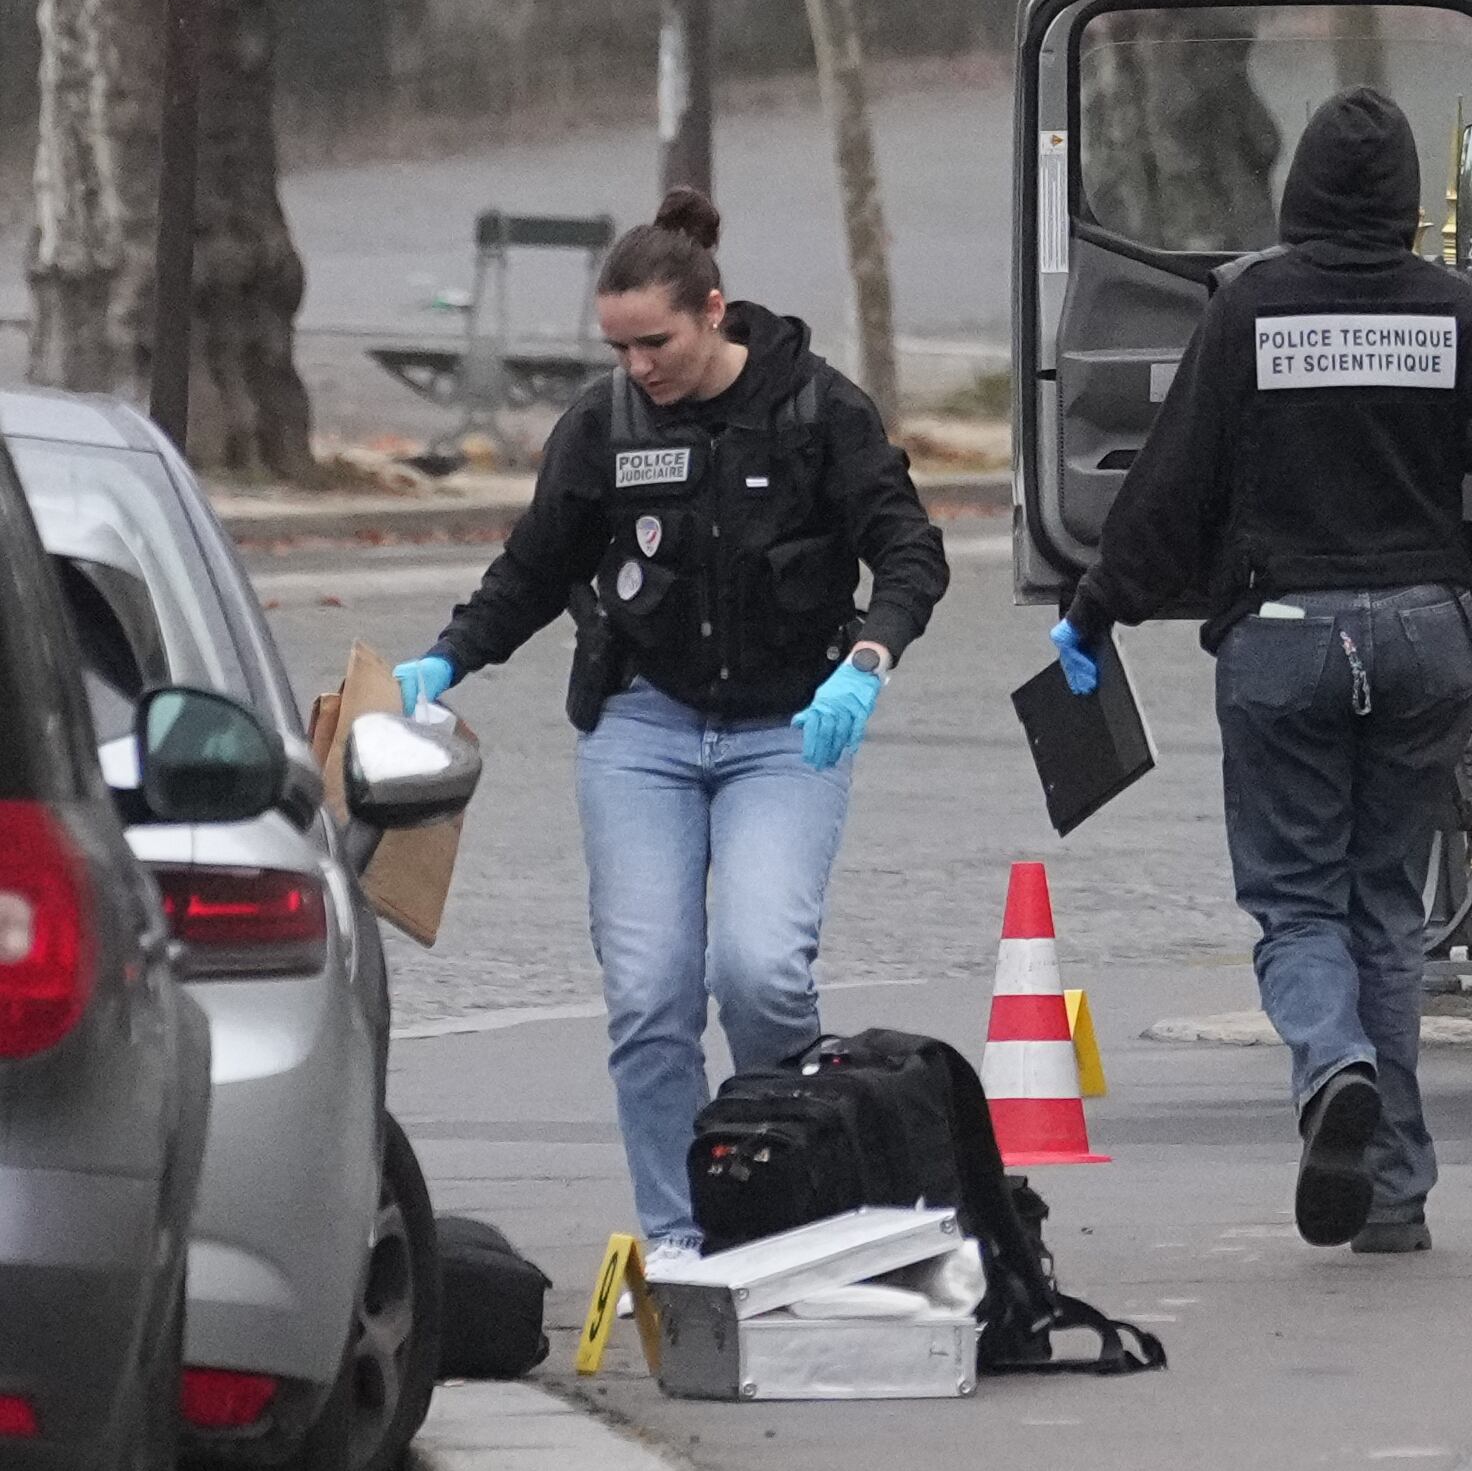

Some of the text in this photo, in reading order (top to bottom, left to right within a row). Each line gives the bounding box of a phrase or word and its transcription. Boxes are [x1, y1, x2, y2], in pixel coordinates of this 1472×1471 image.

[1259, 329, 1453, 350] POLICE TECHNIQUE
[1272, 353, 1441, 374] ET SCIENTIFIQUE
[619, 452, 686, 470] POLICE
[619, 466, 685, 484] JUDICIAIRE
[588, 1250, 618, 1343] 9
